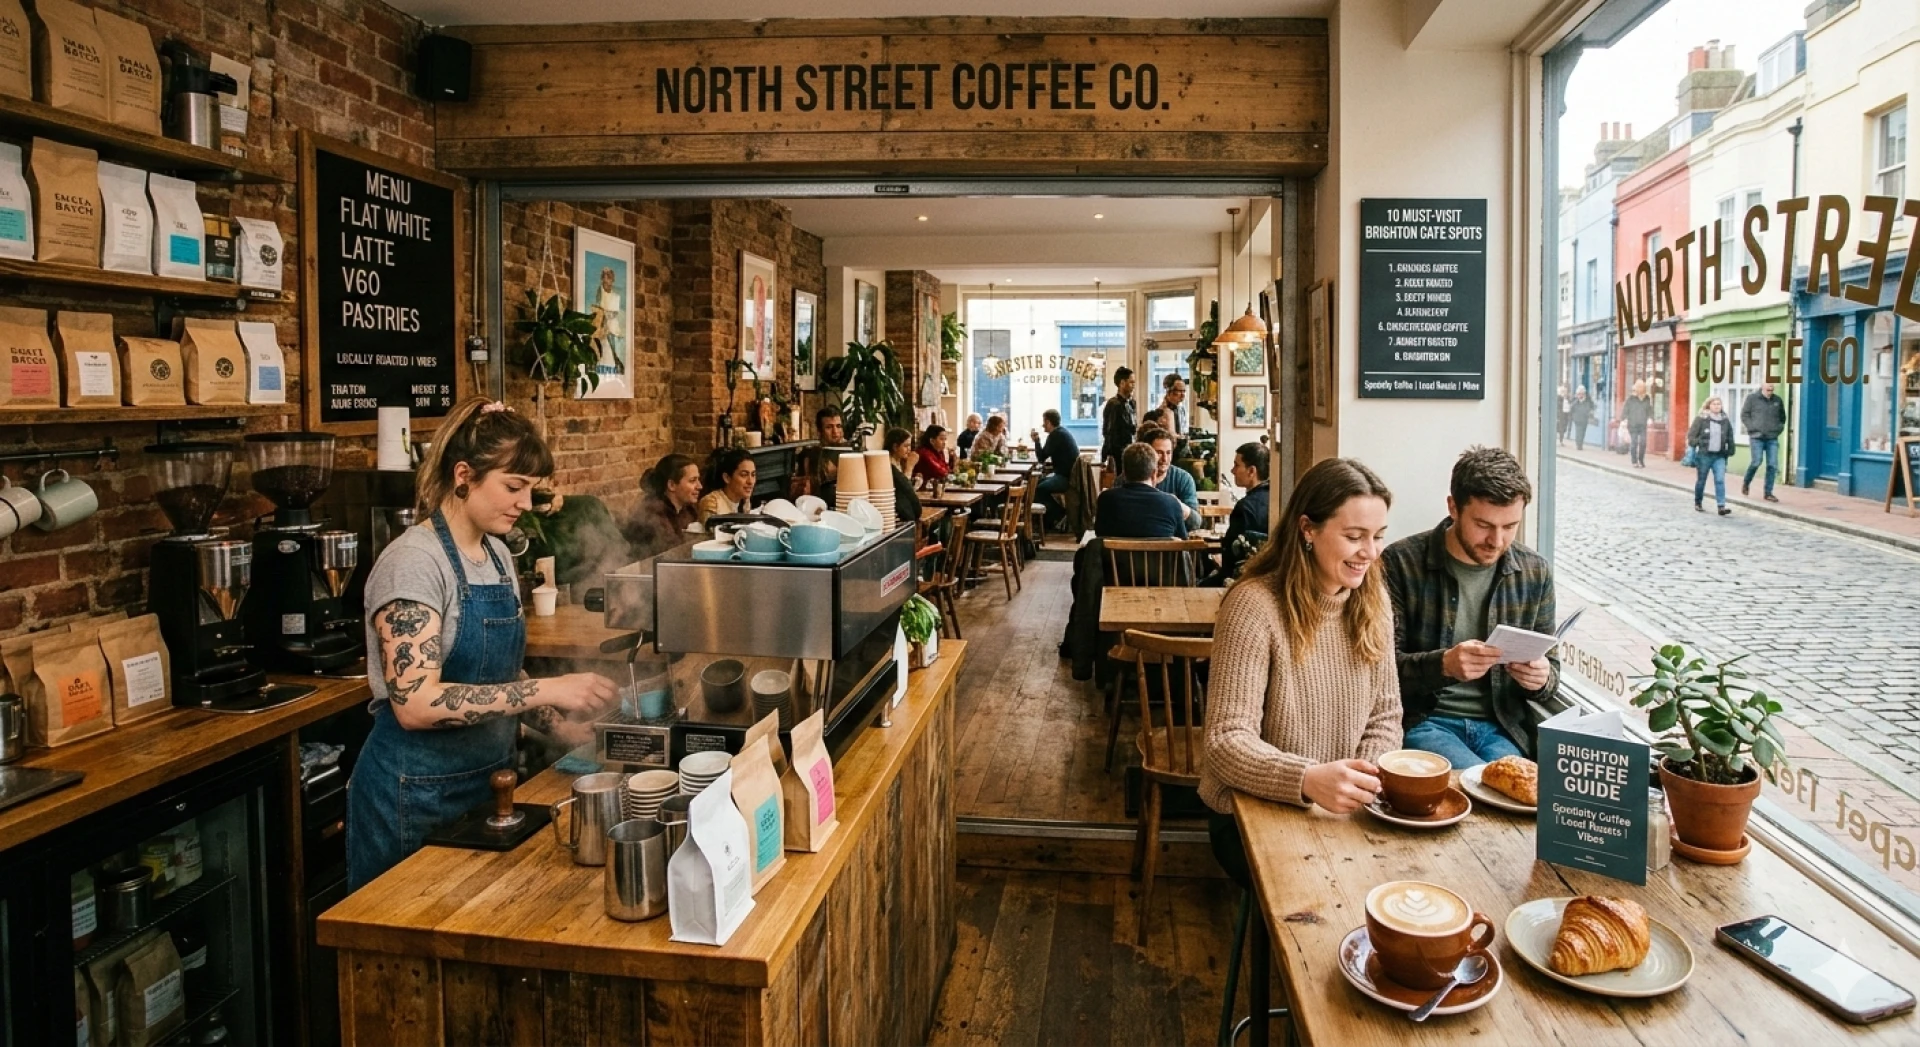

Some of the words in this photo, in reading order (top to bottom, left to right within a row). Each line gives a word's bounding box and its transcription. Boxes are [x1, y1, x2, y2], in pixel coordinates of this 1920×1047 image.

[656, 65, 782, 114] NORTH
[795, 64, 940, 112] STREET
[952, 63, 1096, 111] COFFEE
[1109, 63, 1170, 111] CO.
[366, 170, 411, 205] MENU
[340, 196, 381, 230] FLAT
[385, 207, 432, 242] WHITE
[1387, 209, 1400, 222] 10
[1402, 209, 1462, 223] MUST-VISIT
[341, 231, 396, 267] LATTE
[1448, 226, 1482, 240] SPOTS
[342, 266, 381, 297] V60
[1615, 218, 1722, 346] NORTH
[342, 300, 421, 333] PASTRIES
[1695, 339, 1804, 384] COFFEE
[1819, 336, 1869, 385] CO.
[1557, 743, 1629, 767] BRIGHTON
[1557, 757, 1629, 785] COFFEE
[1563, 776, 1621, 801] GUIDE
